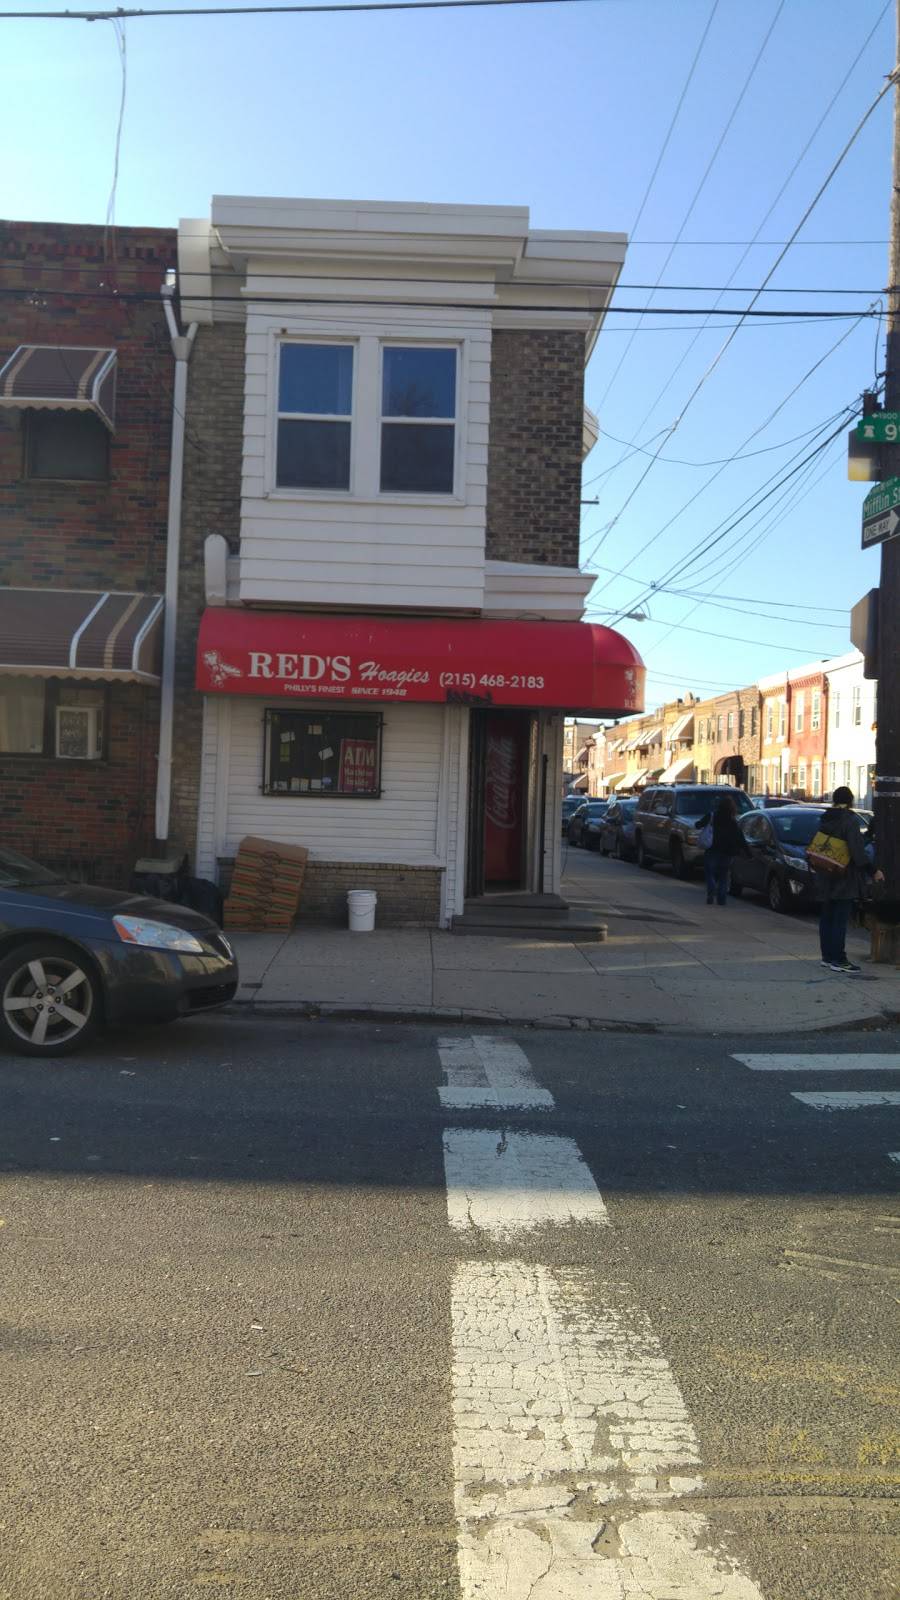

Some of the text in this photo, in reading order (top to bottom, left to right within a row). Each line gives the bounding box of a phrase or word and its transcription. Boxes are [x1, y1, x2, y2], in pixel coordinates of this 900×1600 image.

[885, 424, 900, 441] 9
[864, 495, 890, 515] Mifflin
[865, 518, 890, 538] ONE WAY
[247, 652, 431, 688] RED'S Hoagies
[283, 683, 316, 694] PHILLY'S
[317, 684, 345, 695] FINEST
[350, 686, 380, 696] SINCE
[438, 671, 546, 690] (215) 468-2183
[344, 746, 375, 767] ATM
